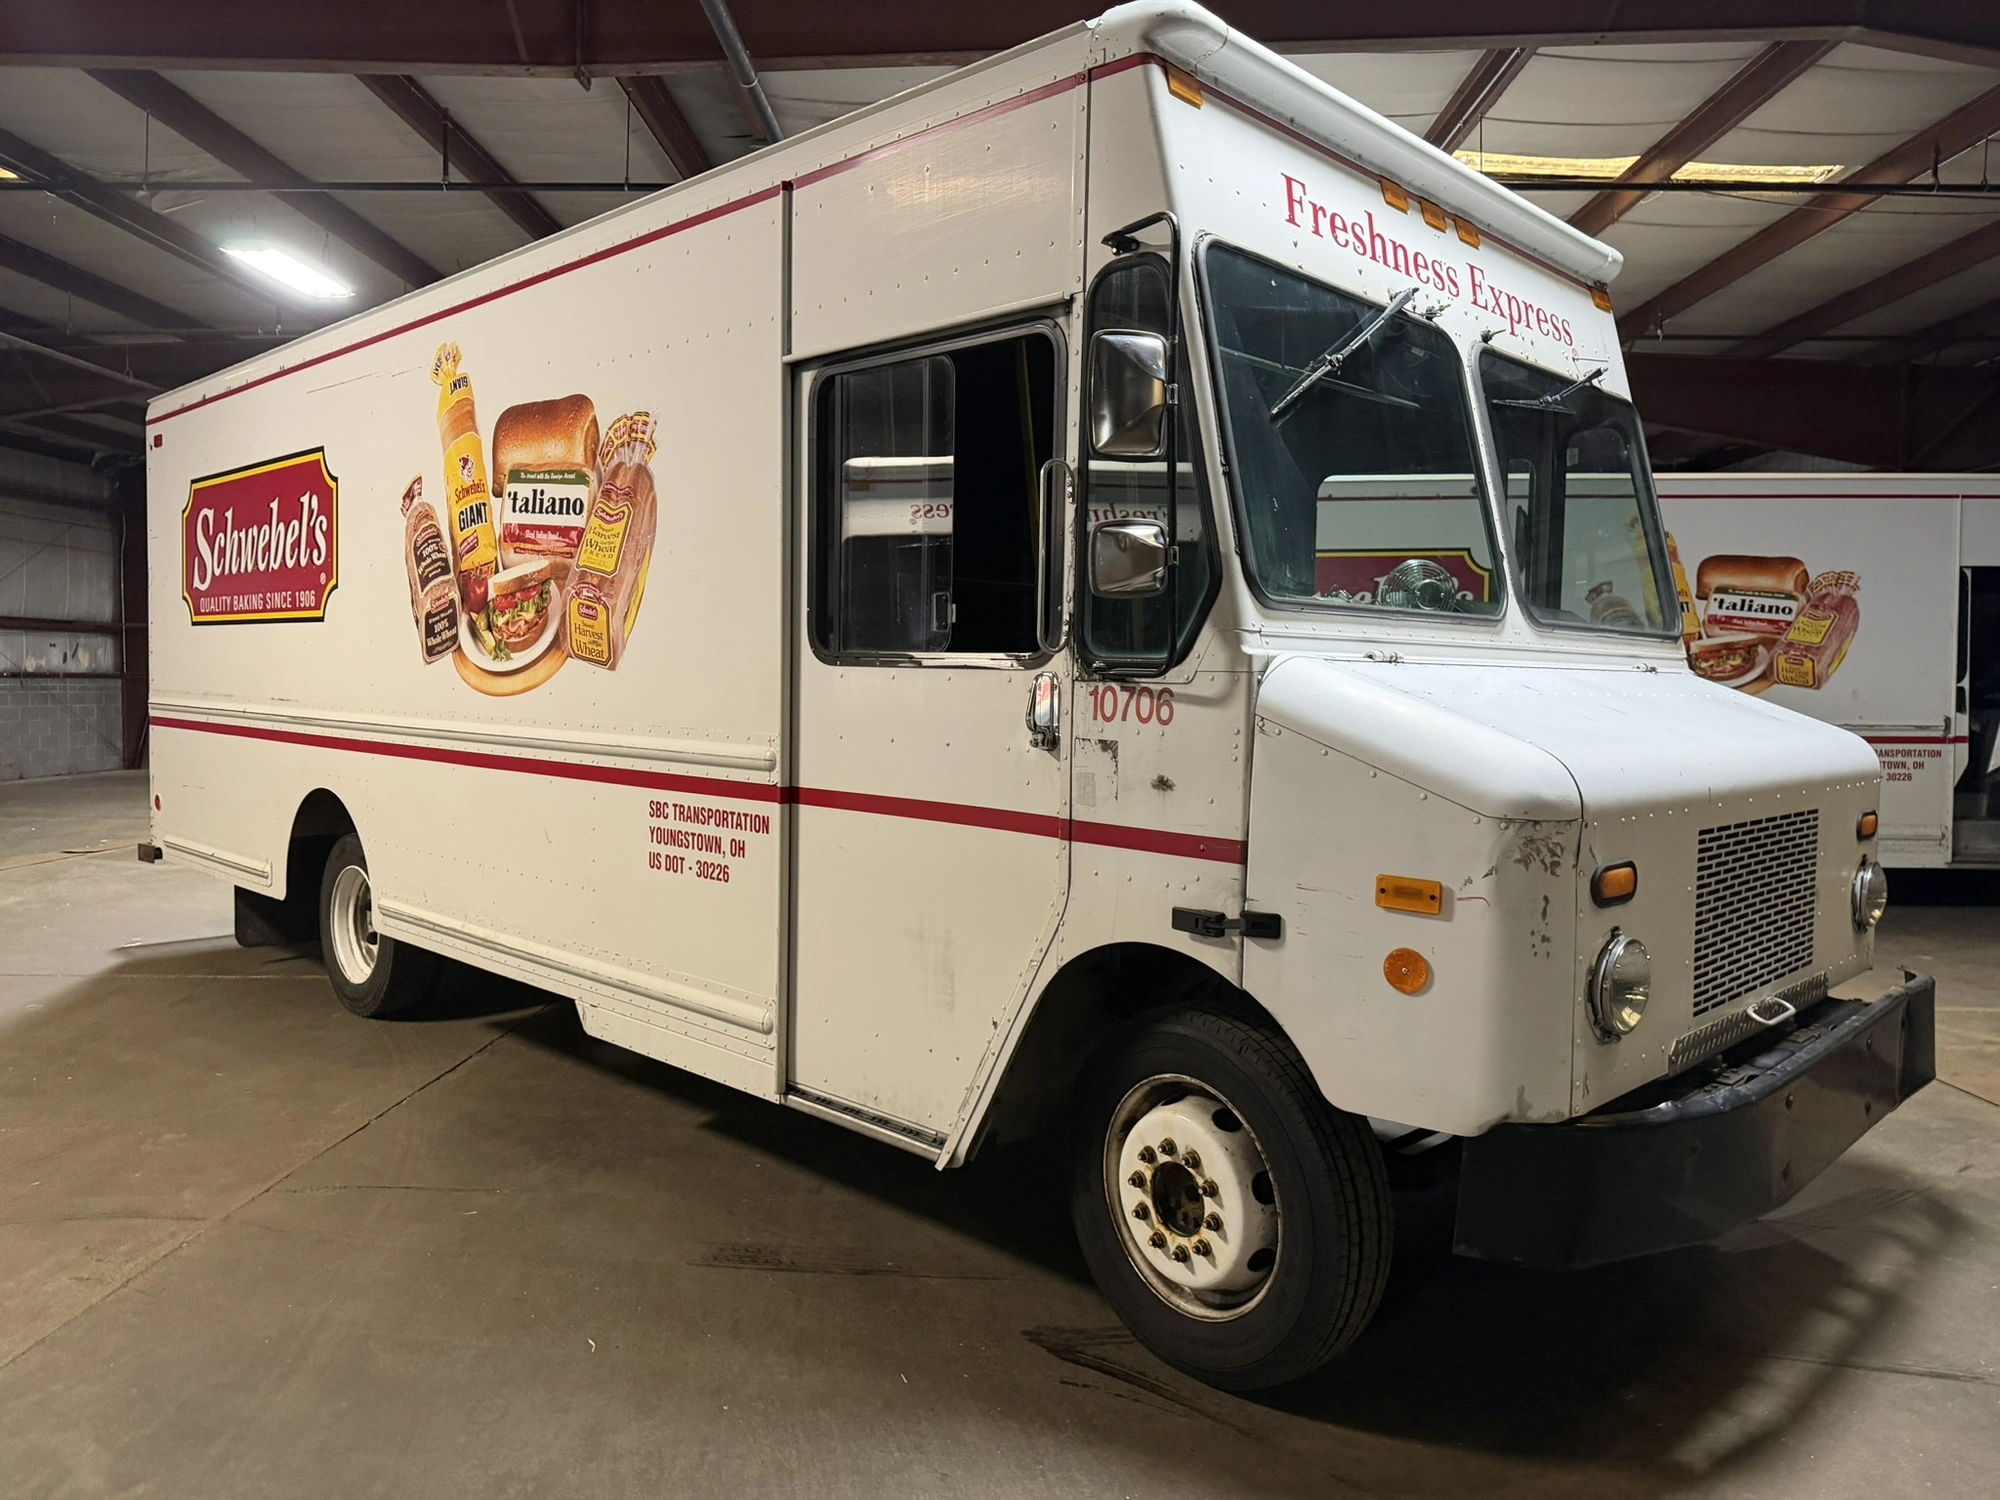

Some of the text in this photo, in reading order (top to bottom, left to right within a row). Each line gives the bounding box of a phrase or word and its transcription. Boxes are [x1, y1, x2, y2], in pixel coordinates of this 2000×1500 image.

[1281, 172, 1573, 346] Freshness Express
[449, 375, 469, 396] GIANT
[455, 479, 486, 504] Schwebel's
[458, 502, 488, 532] GIANT
[193, 490, 328, 591] Schwebel's
[589, 525, 620, 540] Harvest
[585, 538, 617, 553] Wheat
[200, 590, 316, 613] QUALITY BAKING SINCE 1906
[574, 622, 604, 641] Harvest
[575, 638, 605, 659] Wheat
[1088, 685, 1175, 726] 10706
[1886, 773, 1912, 781] 30226
[1913, 761, 1924, 769] OH
[649, 800, 770, 834] SBC TRANSPORTATION
[649, 826, 745, 859] YOUNGSTOWN, OH
[649, 851, 662, 870] US
[665, 854, 685, 874] DOT
[695, 860, 730, 883] 30226
